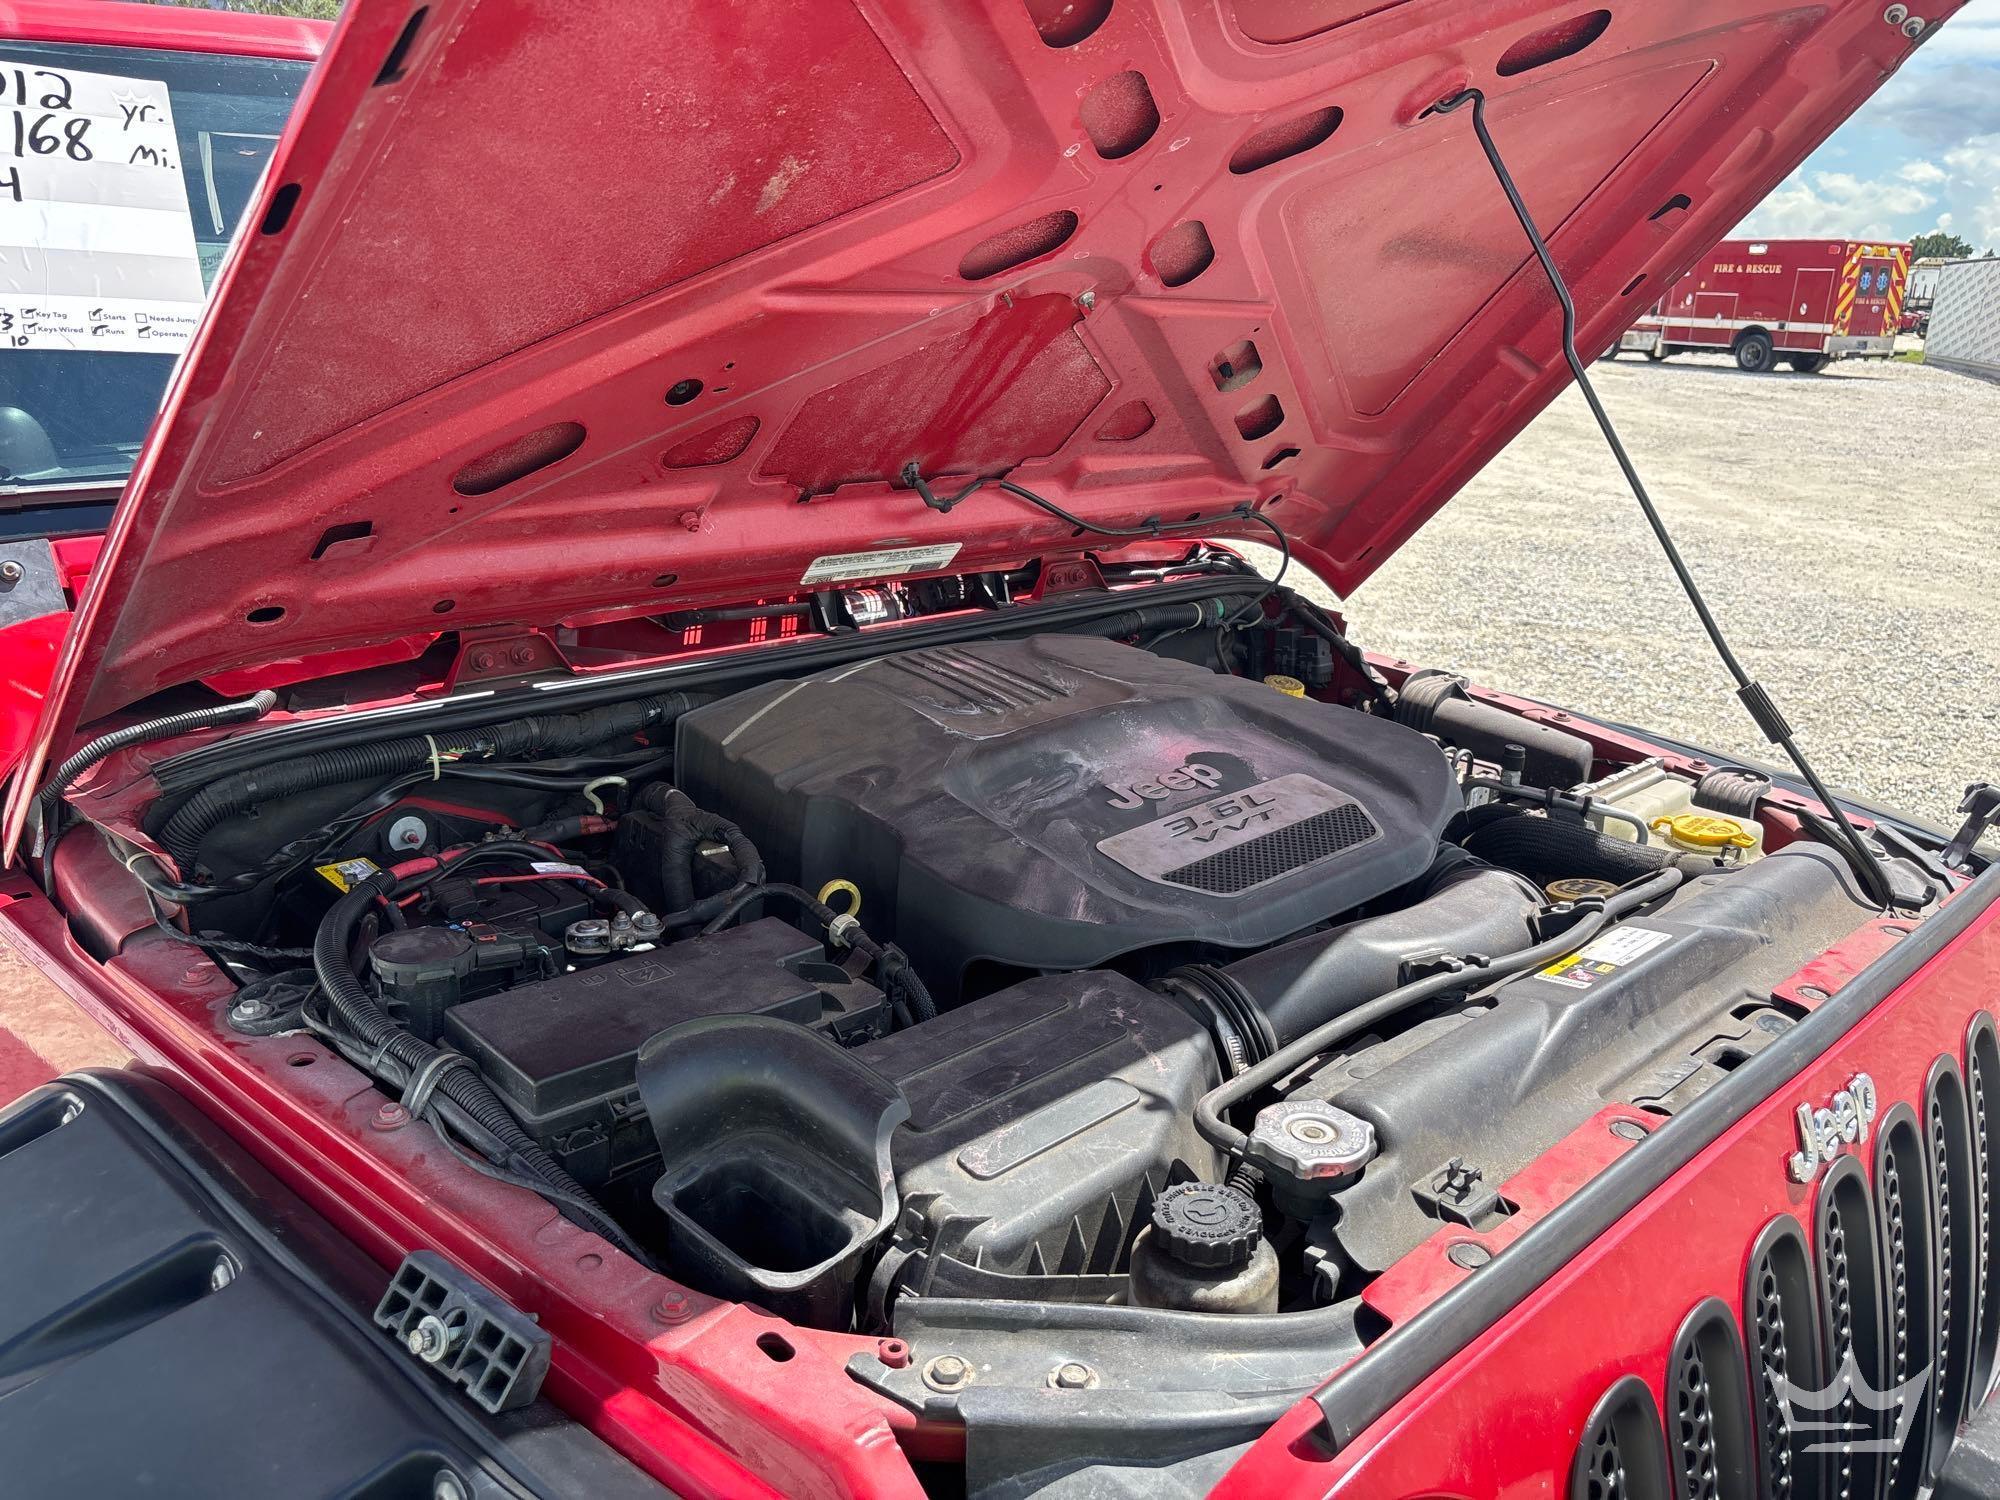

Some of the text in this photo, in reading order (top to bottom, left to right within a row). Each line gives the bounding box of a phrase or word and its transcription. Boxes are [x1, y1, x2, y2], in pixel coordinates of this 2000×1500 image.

[119, 104, 164, 131] yr.
[1713, 263, 1783, 274] FIRE & RESCUE
[36, 311, 68, 320] Key Tag
[103, 313, 126, 321] Starts
[152, 330, 188, 338] Operates
[1104, 762, 1223, 810] Jeep
[1162, 794, 1277, 838] 3.6L
[1192, 808, 1275, 843] VVT
[1789, 1072, 1877, 1184] Jeep
